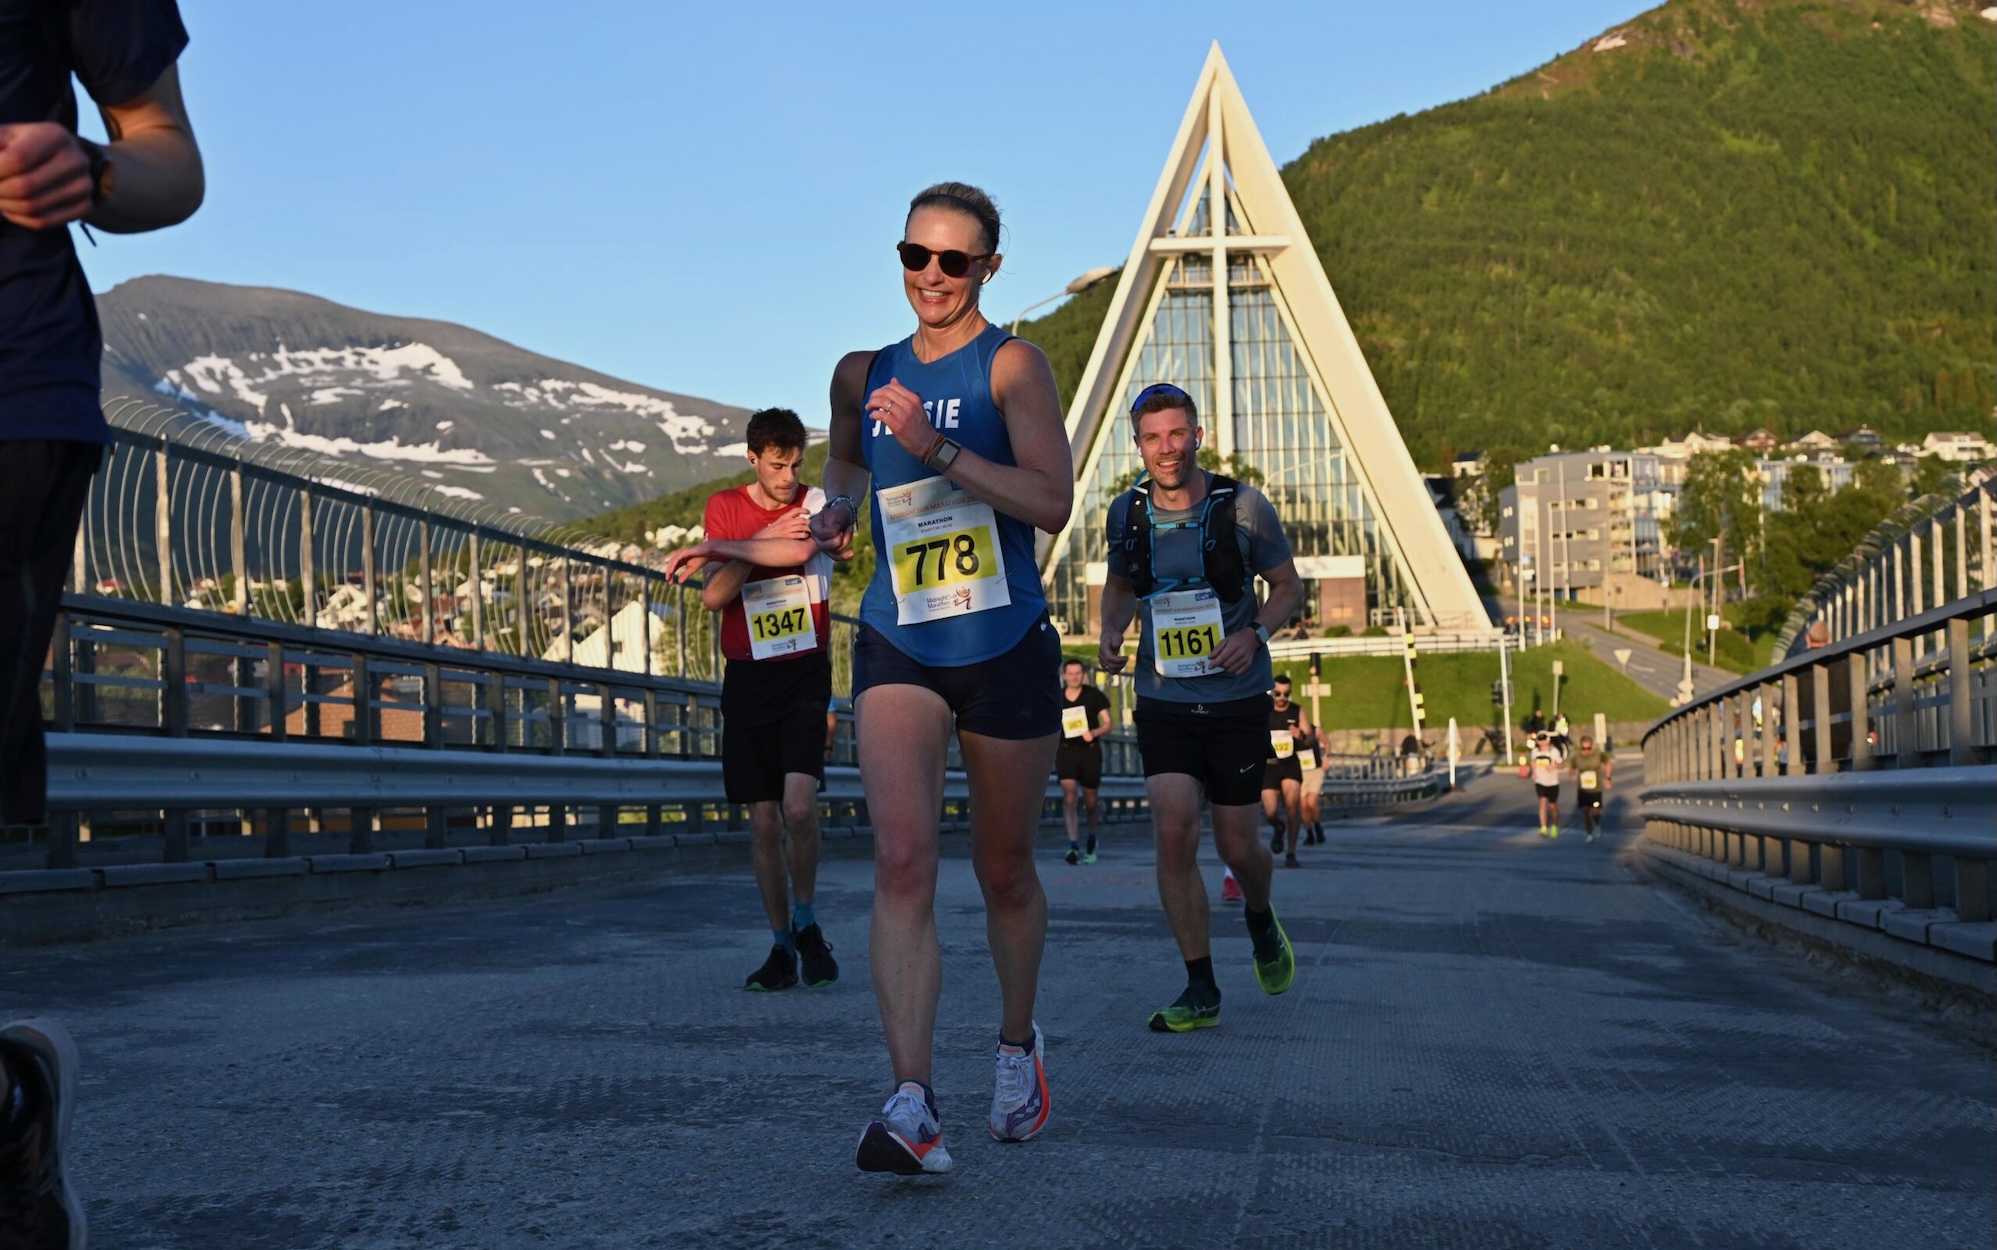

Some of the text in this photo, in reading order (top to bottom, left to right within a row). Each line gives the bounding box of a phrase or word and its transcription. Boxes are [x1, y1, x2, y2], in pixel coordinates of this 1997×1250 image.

[930, 498, 966, 510] MARATHON
[918, 515, 953, 527] MARATHON
[906, 534, 980, 586] 778
[754, 607, 805, 639] 1347
[1161, 626, 1215, 657] 1161
